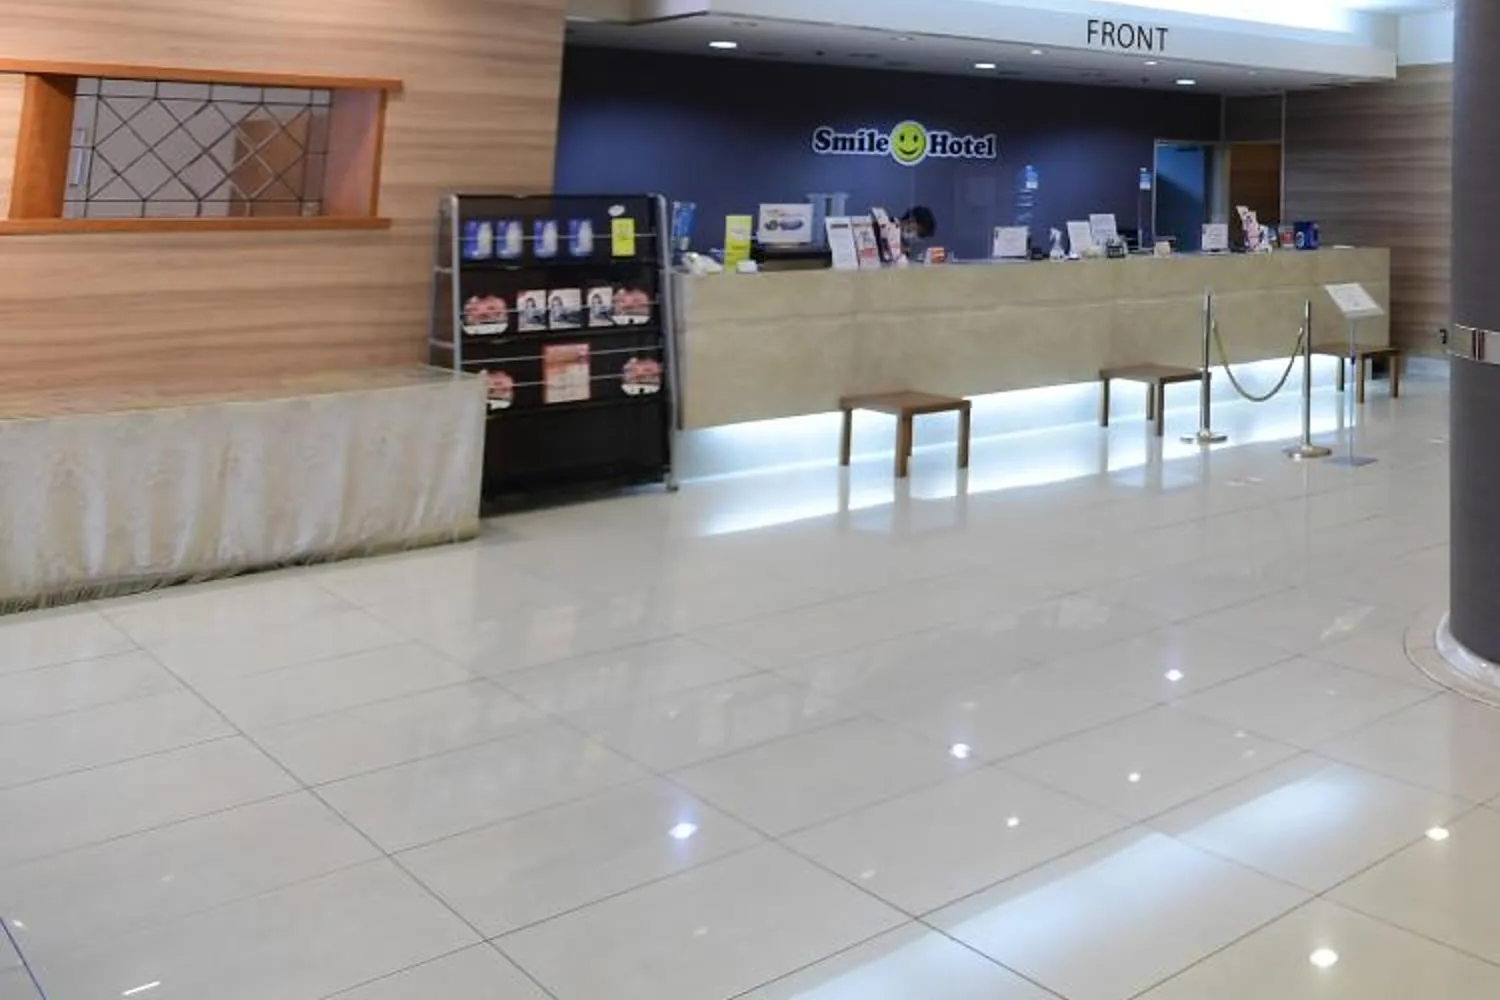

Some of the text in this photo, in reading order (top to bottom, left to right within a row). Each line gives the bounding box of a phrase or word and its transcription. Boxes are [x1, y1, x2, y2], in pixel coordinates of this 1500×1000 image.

[1086, 19, 1169, 52] FRONT
[813, 127, 996, 158] Smile Hotel
